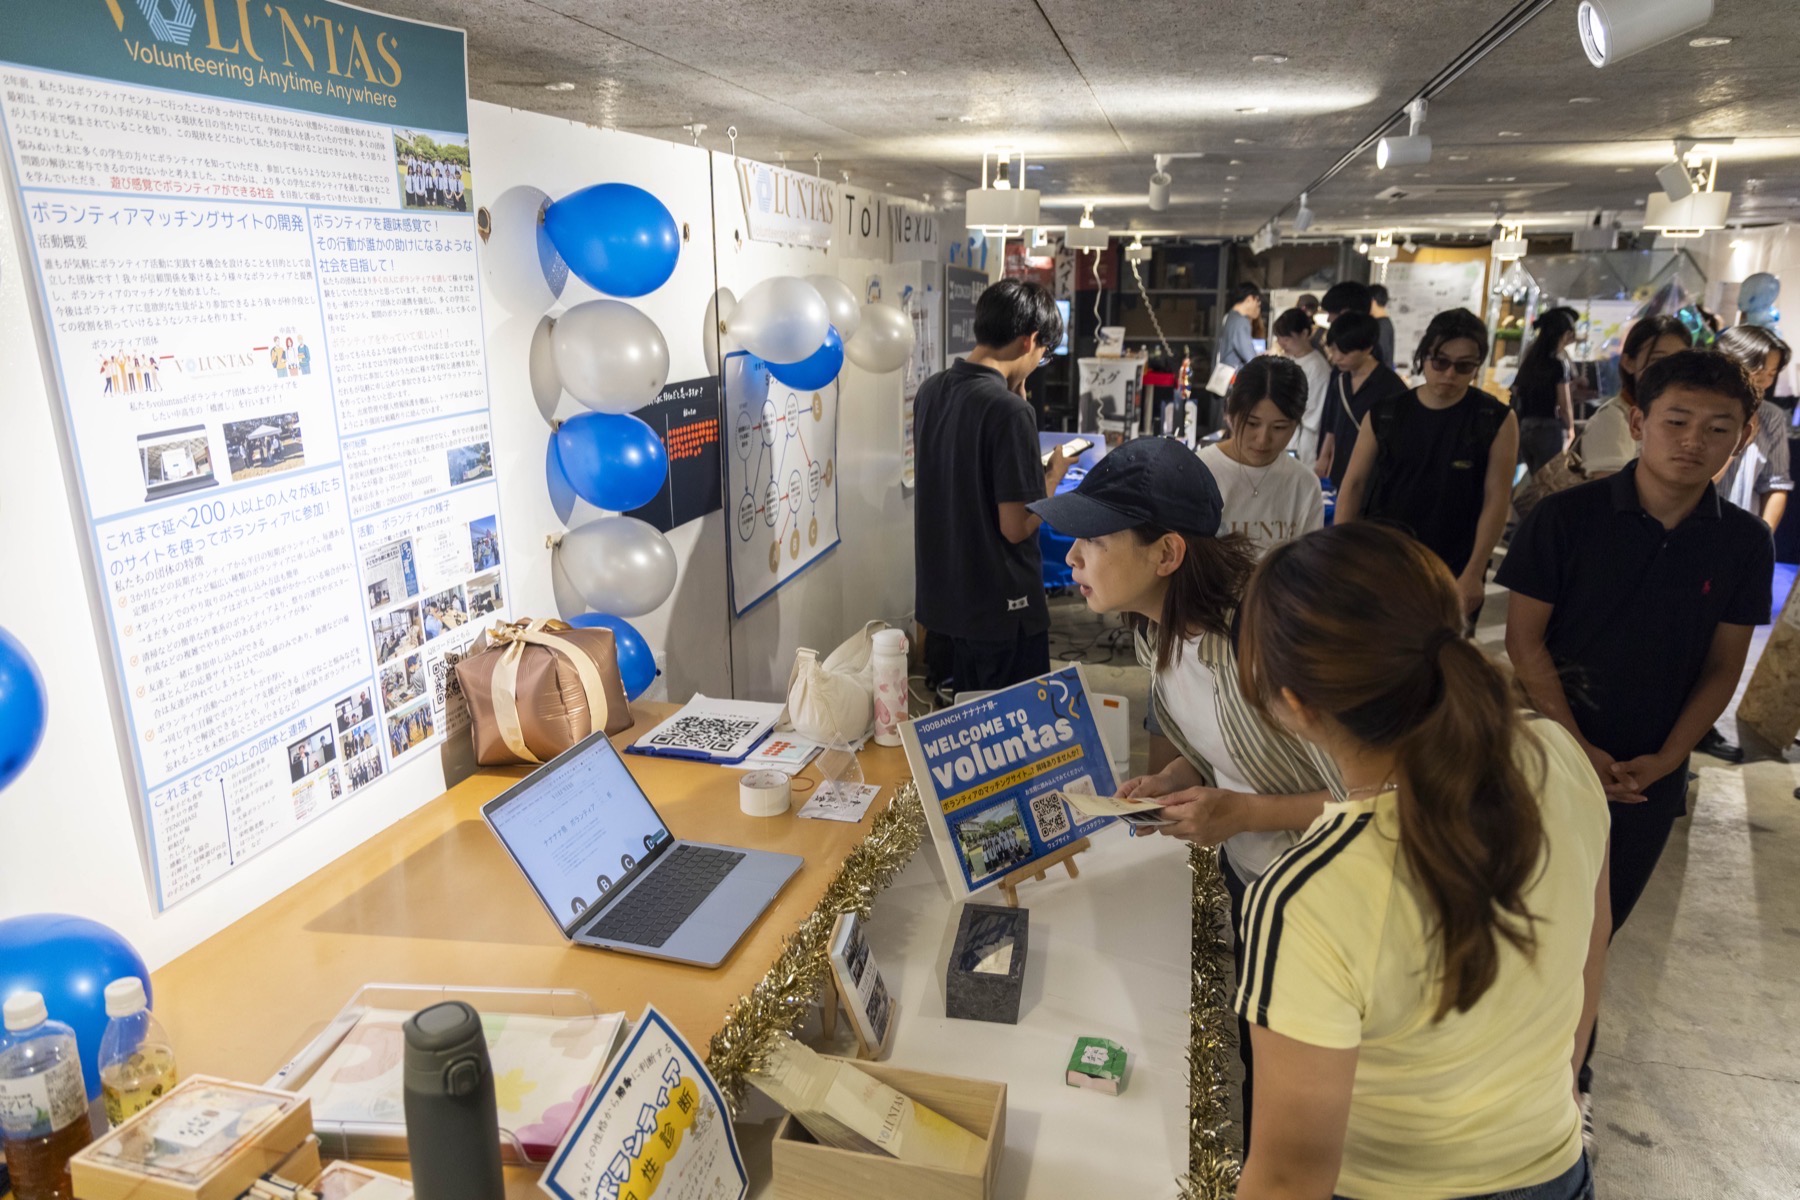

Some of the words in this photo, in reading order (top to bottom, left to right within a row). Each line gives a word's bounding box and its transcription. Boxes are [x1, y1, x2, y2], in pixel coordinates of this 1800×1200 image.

[124, 39, 254, 87] Volunteering
[259, 65, 323, 95] Anytime
[327, 79, 397, 108] Anywhere
[31, 203, 304, 232] ボランティアマッチングサイトの開発
[312, 213, 439, 233] ボランティアを趣味感覚で！
[38, 234, 89, 250] 活動概要
[316, 236, 473, 252] その行動が誰かの助けになるような
[319, 257, 395, 273] 社会を目指して！
[92, 335, 159, 350] ボランティア団体
[109, 502, 331, 577] のサイトを使ってボランティアに参加！
[924, 717, 1005, 759] WELCOME
[1005, 708, 1029, 728] TO
[932, 718, 1074, 790] voluntas
[569, 804, 596, 827] ボランティア
[1047, 834, 1071, 850] ウェブサイト
[624, 857, 634, 869] C
[600, 879, 610, 890] B
[624, 1087, 694, 1200] 性診断
